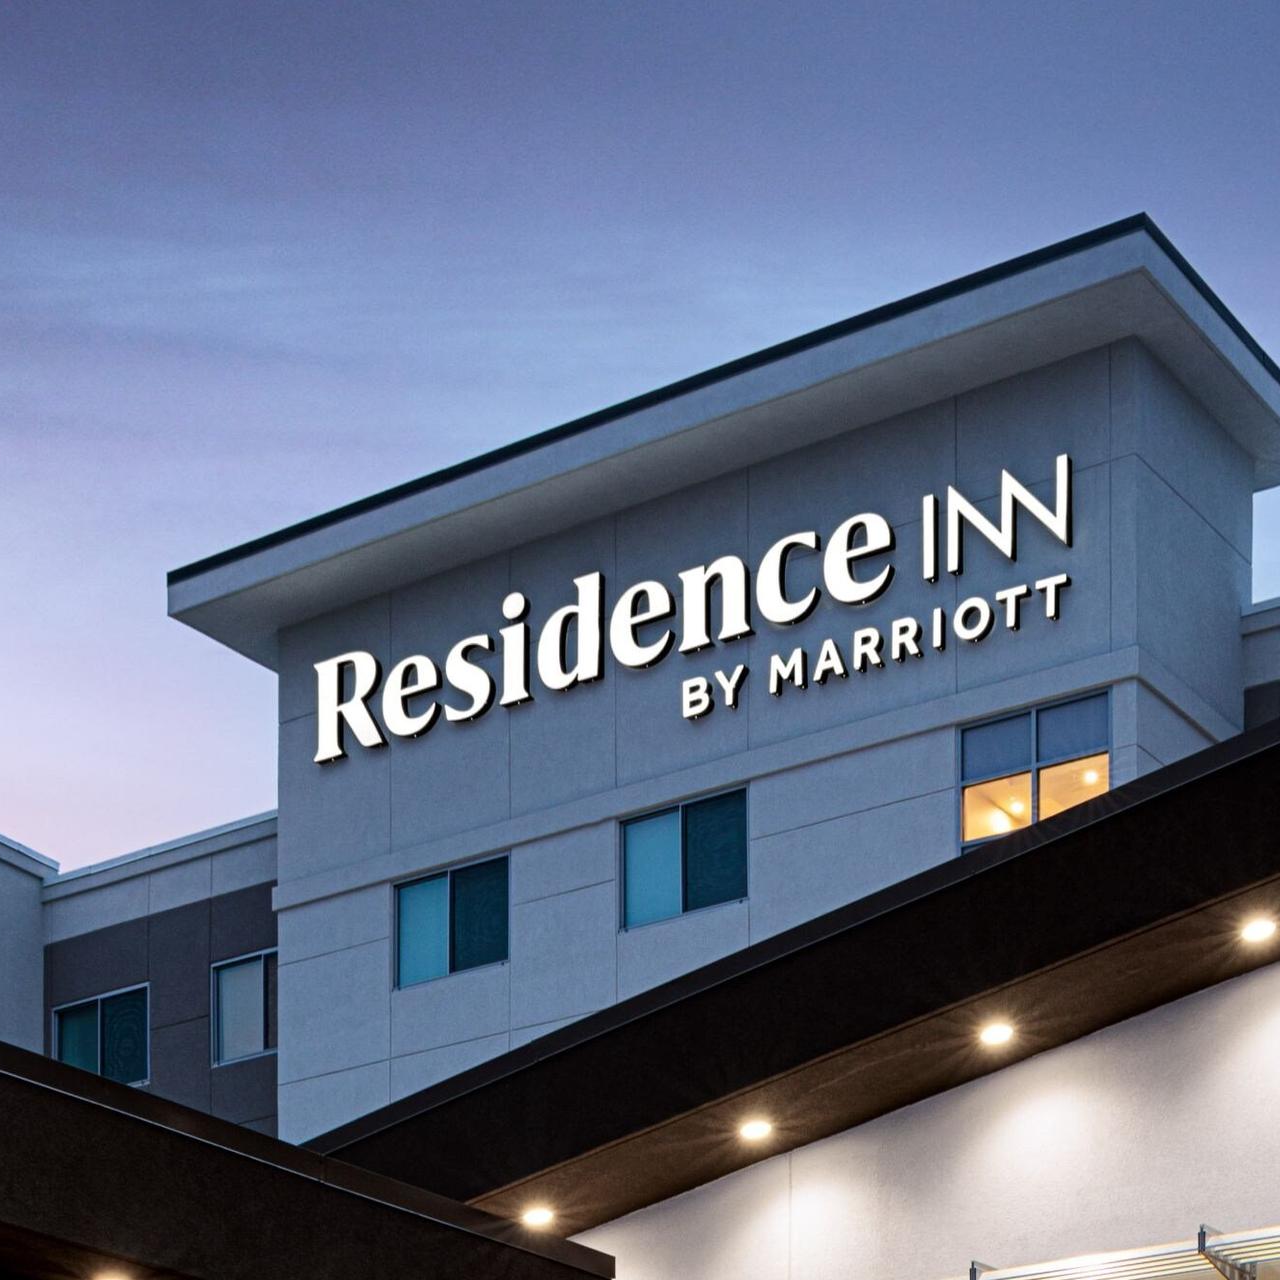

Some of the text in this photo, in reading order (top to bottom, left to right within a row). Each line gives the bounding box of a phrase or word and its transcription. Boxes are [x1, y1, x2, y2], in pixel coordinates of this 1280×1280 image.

[314, 454, 1072, 763] Residence INN
[681, 573, 1069, 719] BY MARRIOTT
